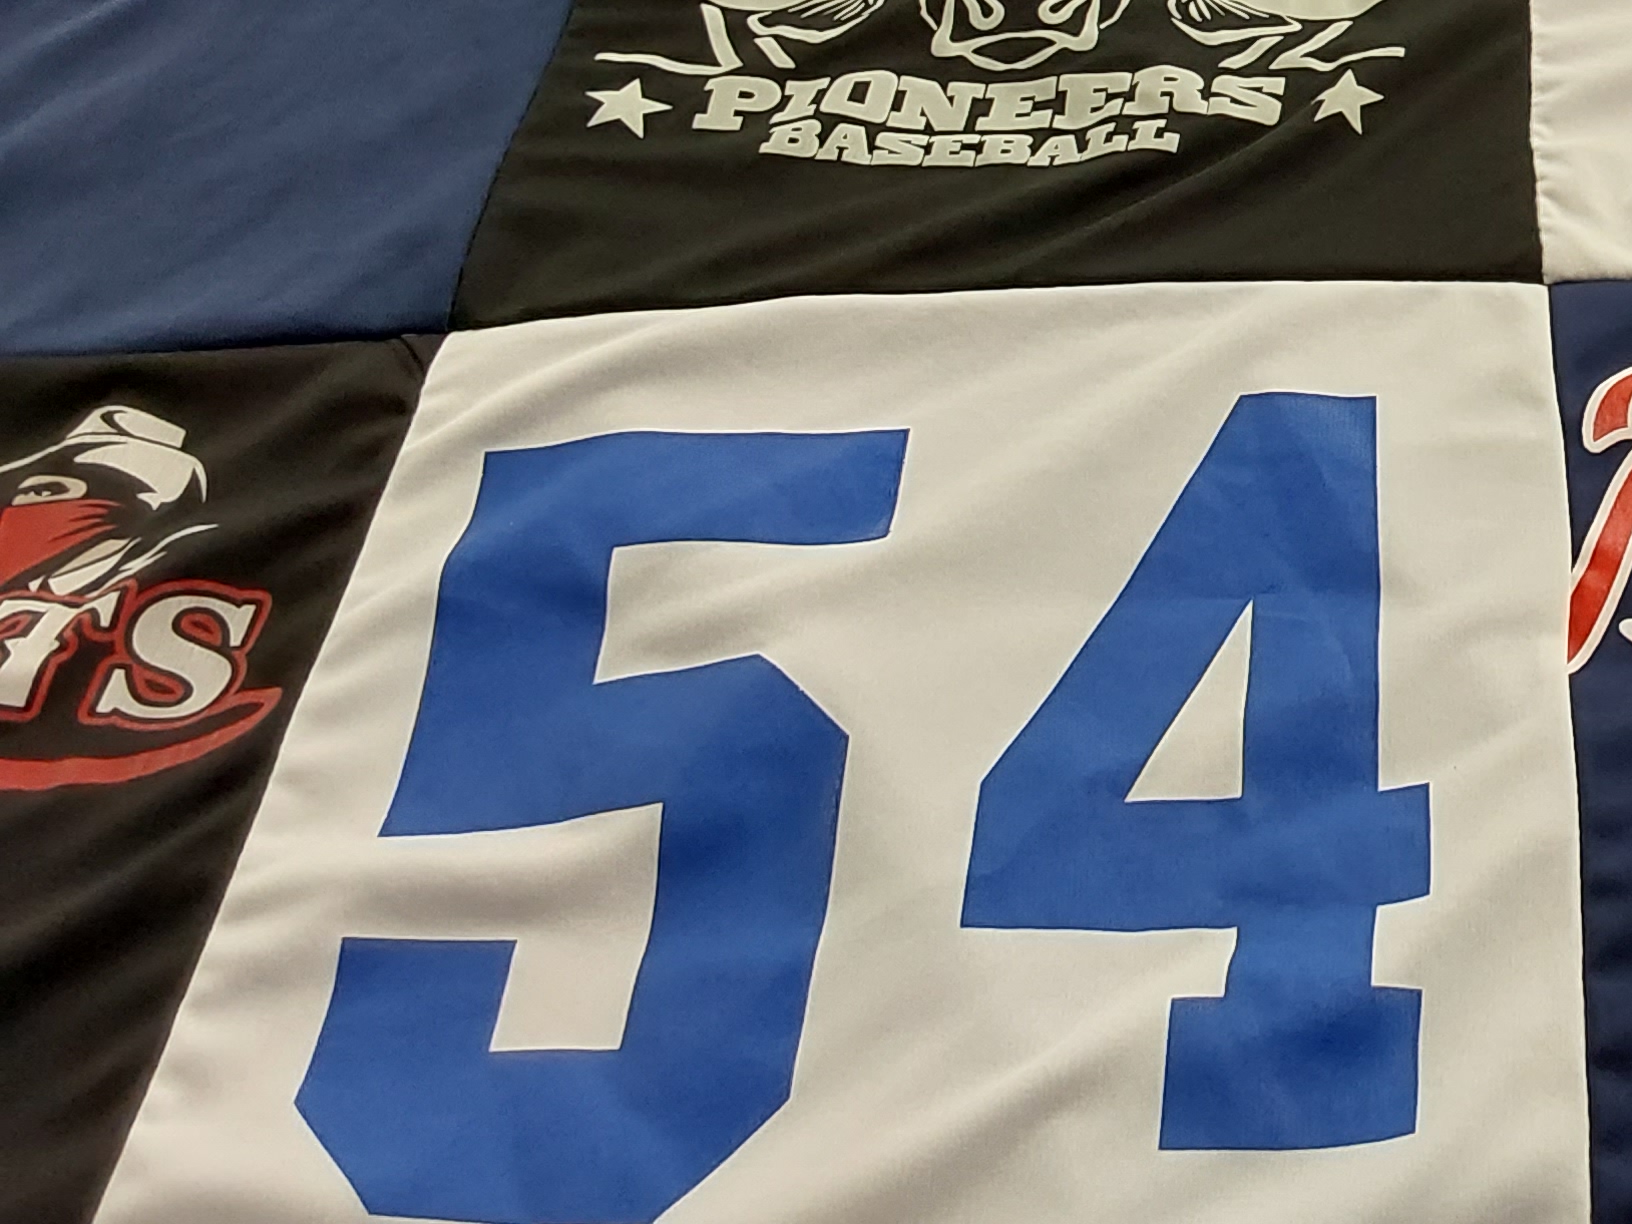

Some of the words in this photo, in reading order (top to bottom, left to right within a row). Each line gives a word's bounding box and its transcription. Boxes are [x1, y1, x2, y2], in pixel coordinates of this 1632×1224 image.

[693, 66, 1286, 131] PIONEERS
[759, 118, 1181, 167] BASEBALL
[294, 391, 1432, 1224] 54
